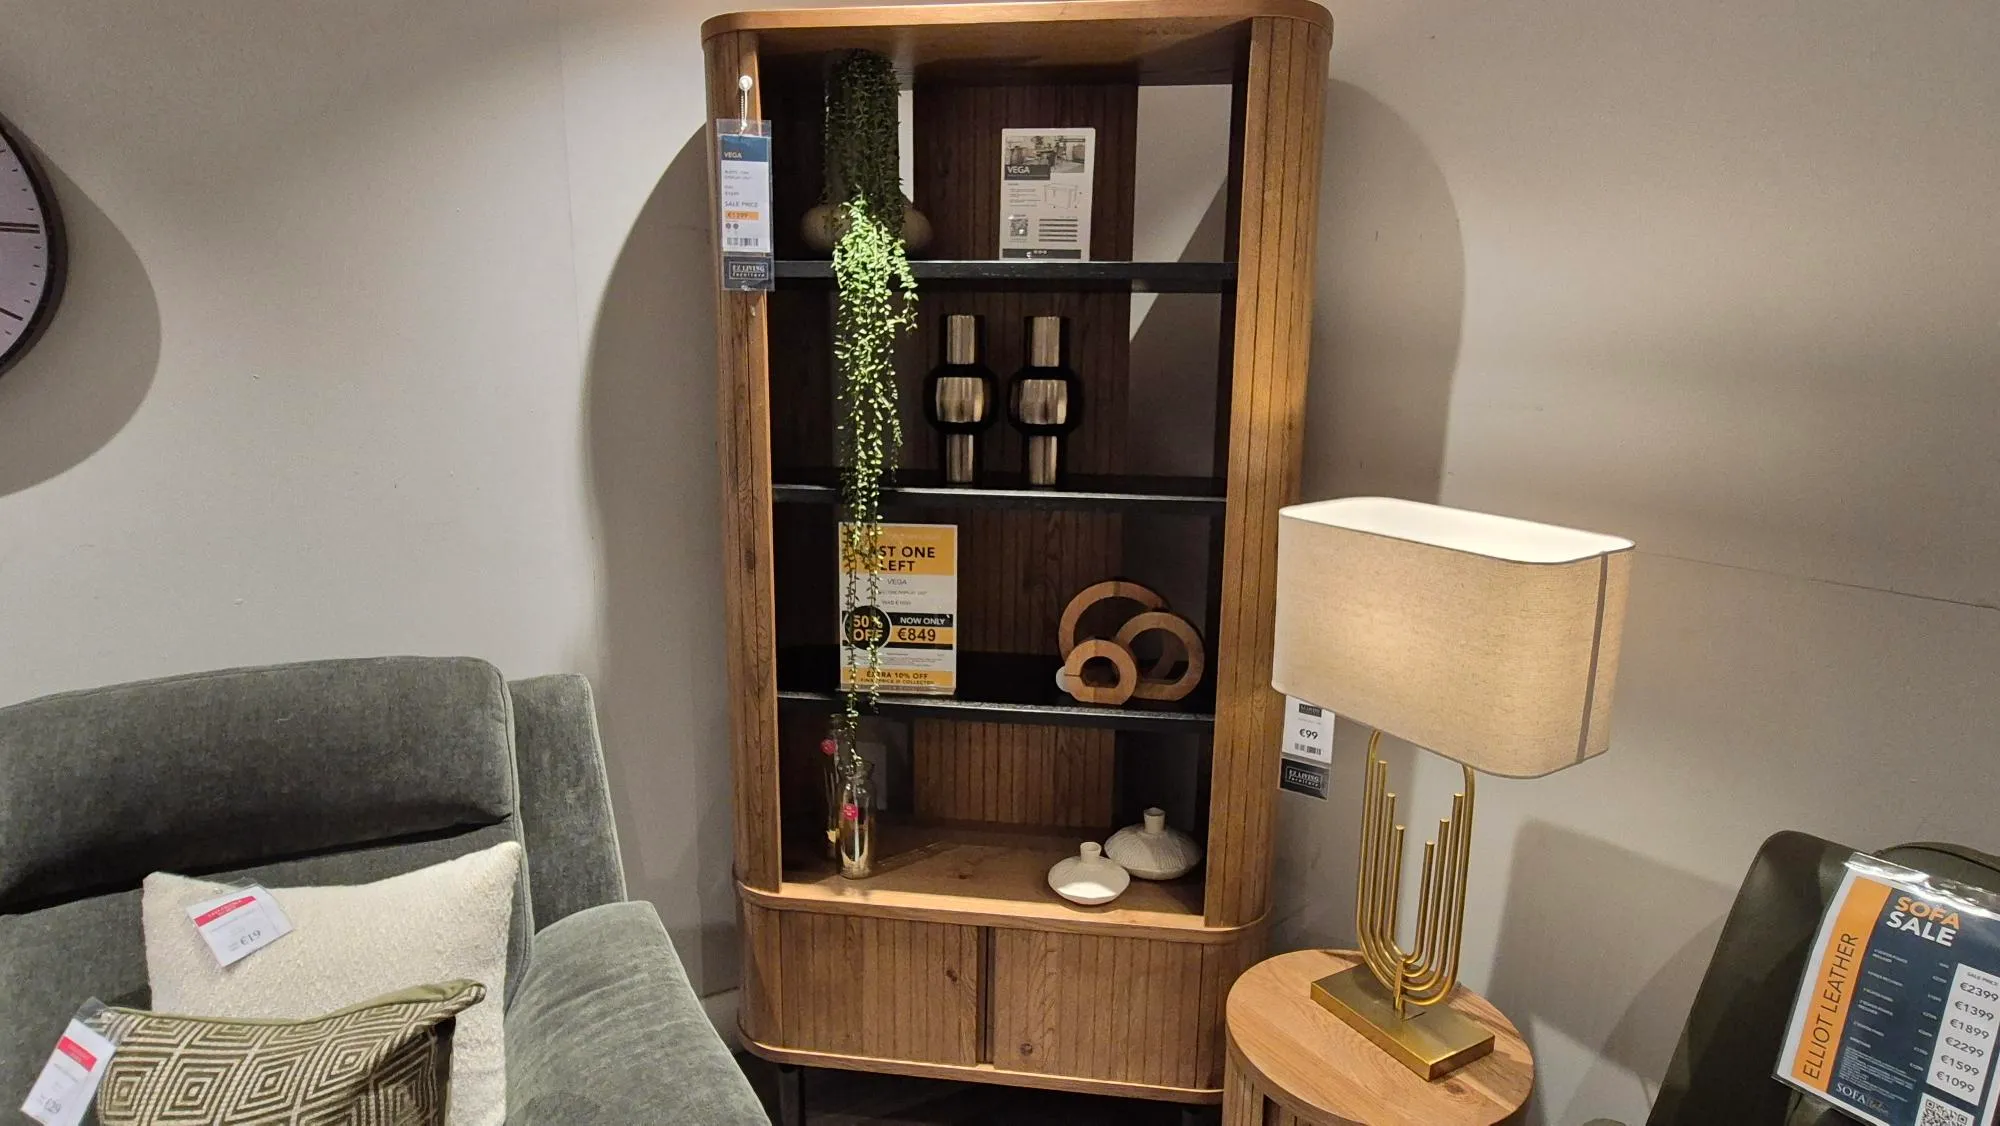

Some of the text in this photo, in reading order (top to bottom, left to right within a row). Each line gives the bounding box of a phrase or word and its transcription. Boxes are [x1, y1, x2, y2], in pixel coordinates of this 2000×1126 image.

[1007, 166, 1030, 174] VEGA
[902, 547, 936, 559] ONE
[880, 560, 916, 572] LEFT
[900, 616, 946, 626] NOW ONLY
[853, 628, 883, 642] OFF
[897, 627, 936, 642] €849
[912, 672, 929, 680] OFF
[1299, 728, 1319, 740] €99
[1894, 896, 1960, 930] SOFA
[240, 929, 262, 946] €19
[1886, 911, 1957, 948] SALE
[1960, 982, 1999, 1002] €2399
[1802, 933, 1859, 1080] ELLIOT LEATHER
[1955, 1000, 1994, 1021] €1399
[1949, 1018, 1990, 1040] €1899
[1945, 1036, 1984, 1058] €2299
[1941, 1054, 1980, 1076] €1599
[1936, 1071, 1975, 1093] €1099
[1836, 1082, 1867, 1105] SOFA
